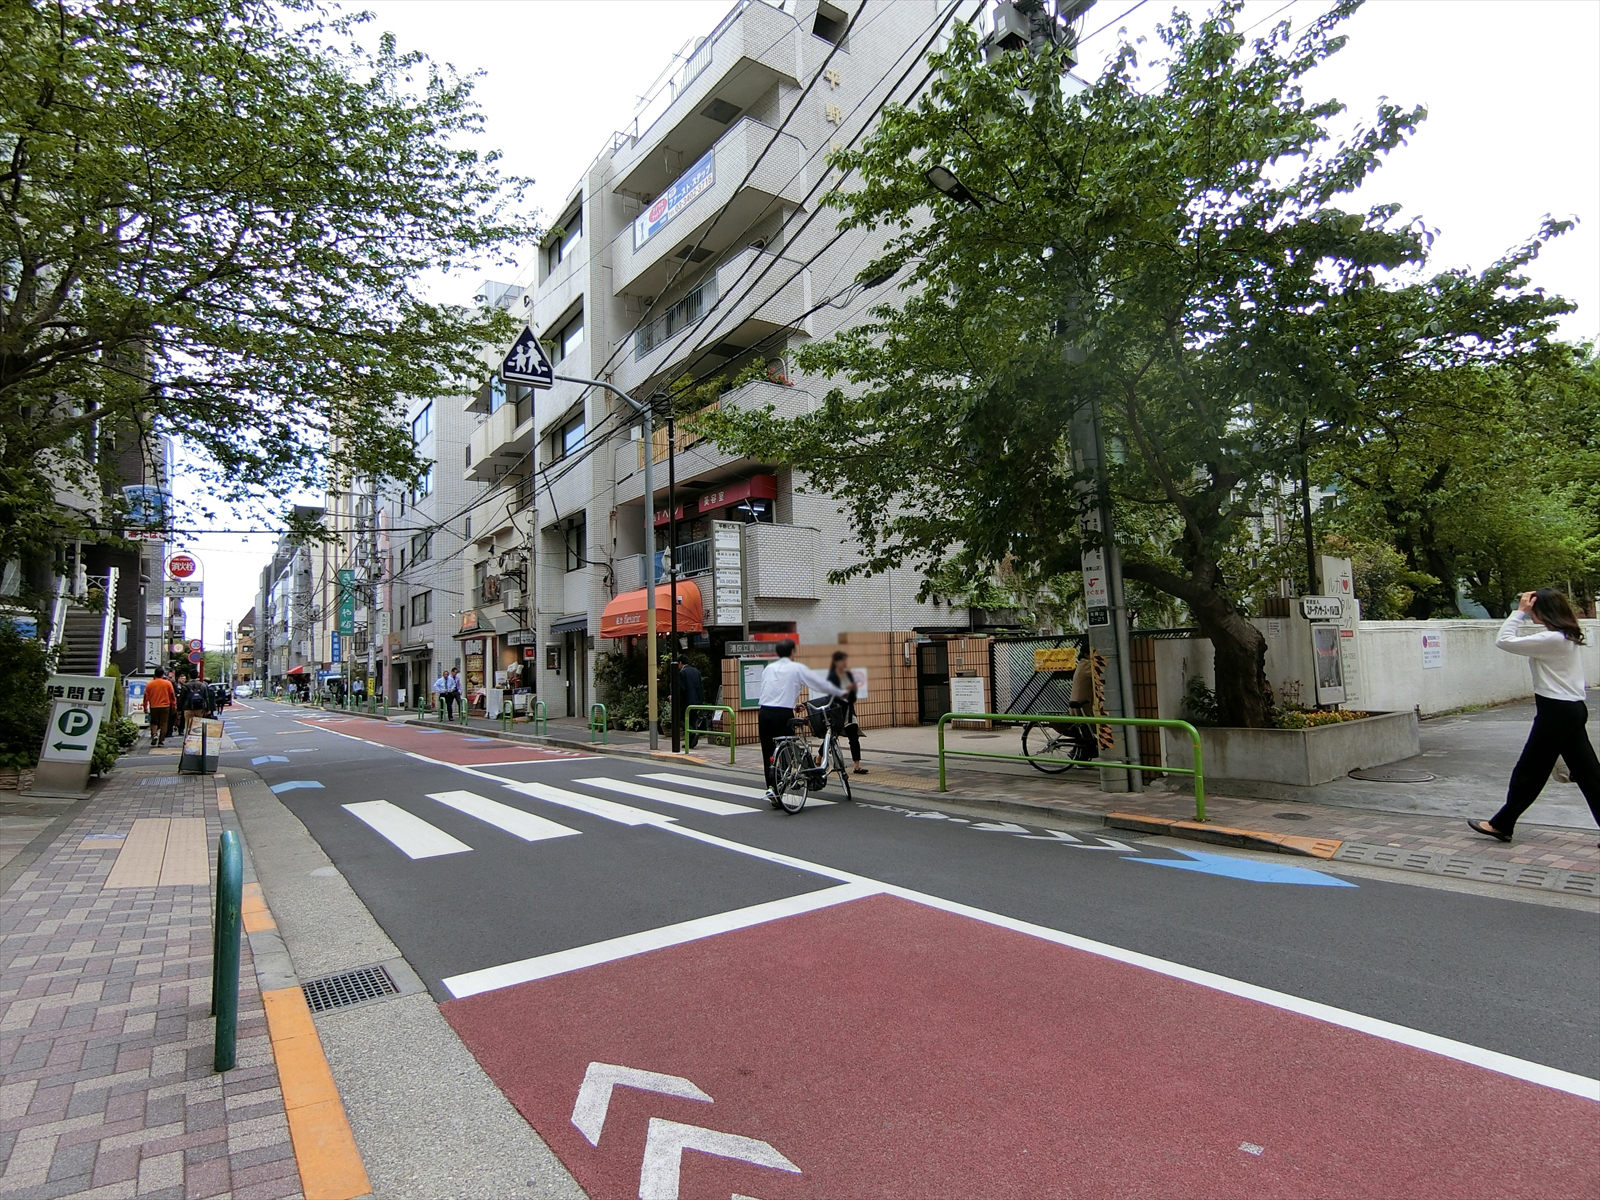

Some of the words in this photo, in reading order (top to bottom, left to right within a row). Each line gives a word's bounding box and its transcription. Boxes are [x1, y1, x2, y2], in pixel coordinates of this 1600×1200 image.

[703, 491, 725, 507] 美容室
[171, 562, 194, 571] 消火栓
[165, 586, 199, 594] 大江戸
[64, 711, 89, 734] P
